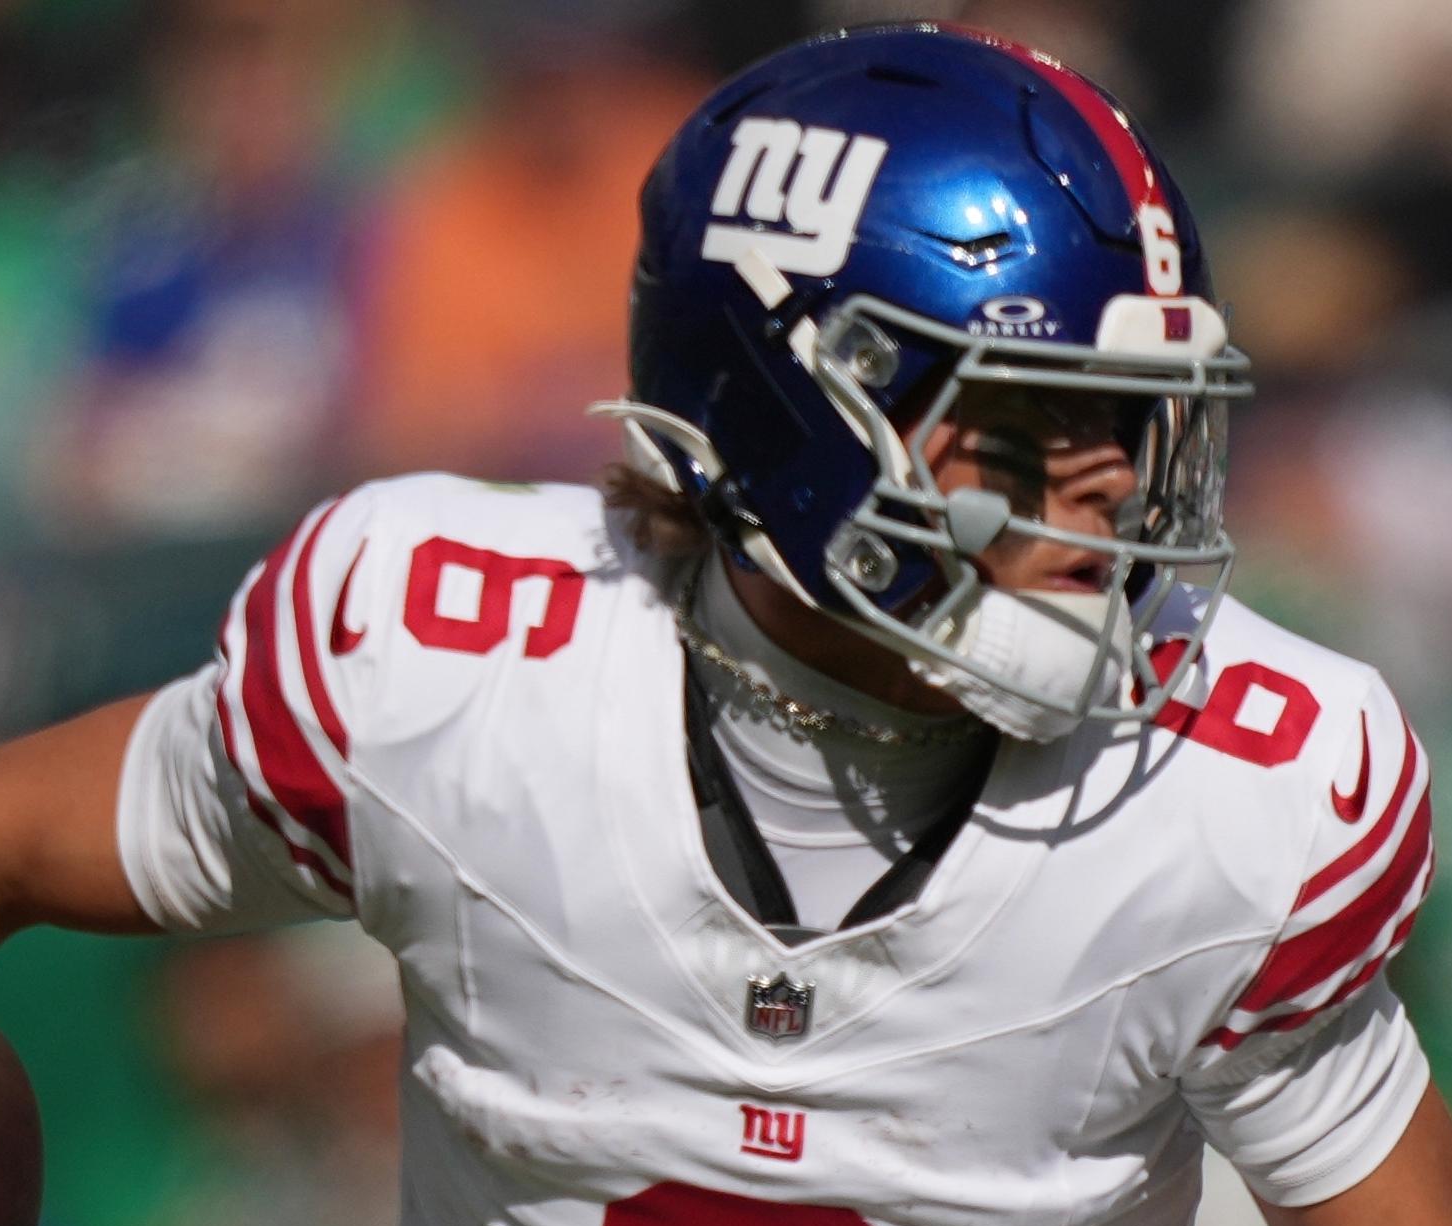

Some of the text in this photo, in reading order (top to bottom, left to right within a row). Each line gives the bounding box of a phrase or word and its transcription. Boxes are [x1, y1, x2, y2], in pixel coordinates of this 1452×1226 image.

[701, 117, 889, 277] ny
[1138, 204, 1182, 297] 6
[402, 534, 587, 661] 6
[1129, 634, 1323, 770] 6
[756, 1006, 802, 1033] NFL
[739, 1103, 806, 1163] ny
